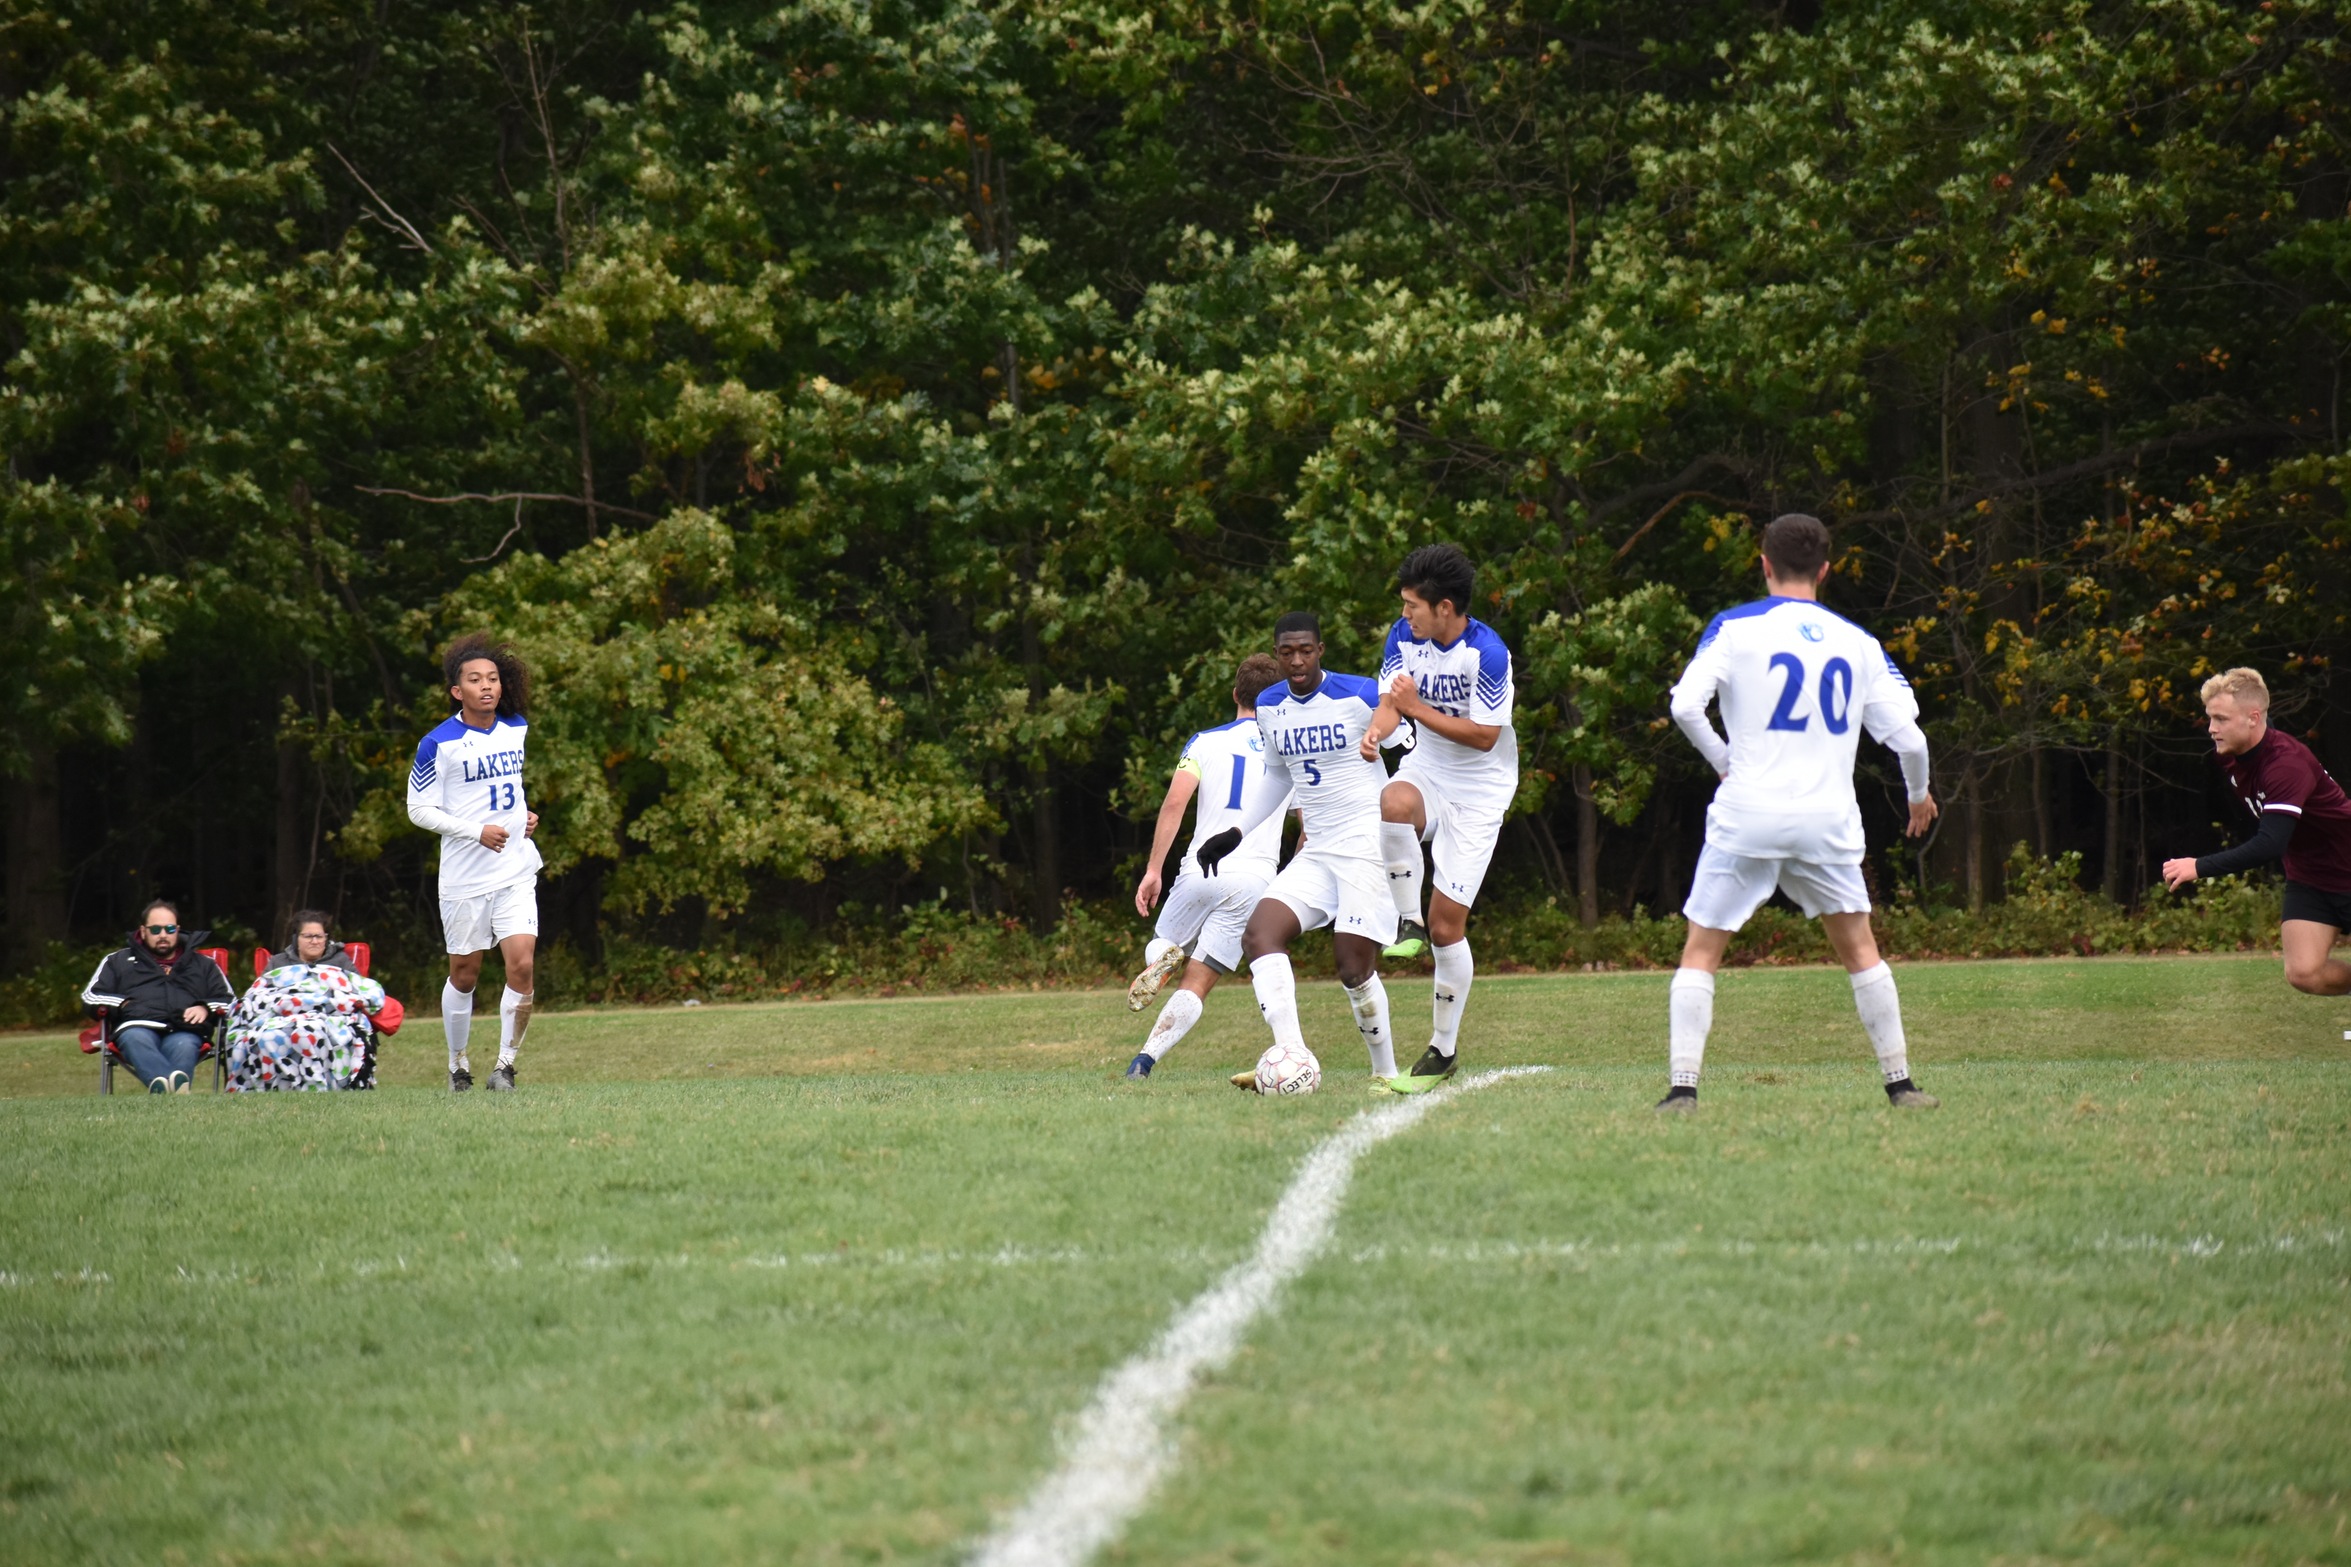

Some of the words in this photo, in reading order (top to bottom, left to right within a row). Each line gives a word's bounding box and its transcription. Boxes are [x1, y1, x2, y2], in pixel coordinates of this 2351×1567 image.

[1409, 670, 1471, 703] AKERS
[1766, 652, 1852, 735] 20
[1273, 723, 1347, 756] LAKERS
[463, 749, 524, 783] LAKERS
[1303, 758, 1321, 786] 5
[488, 782, 515, 811] 13
[1282, 1068, 1312, 1094] SELECT
